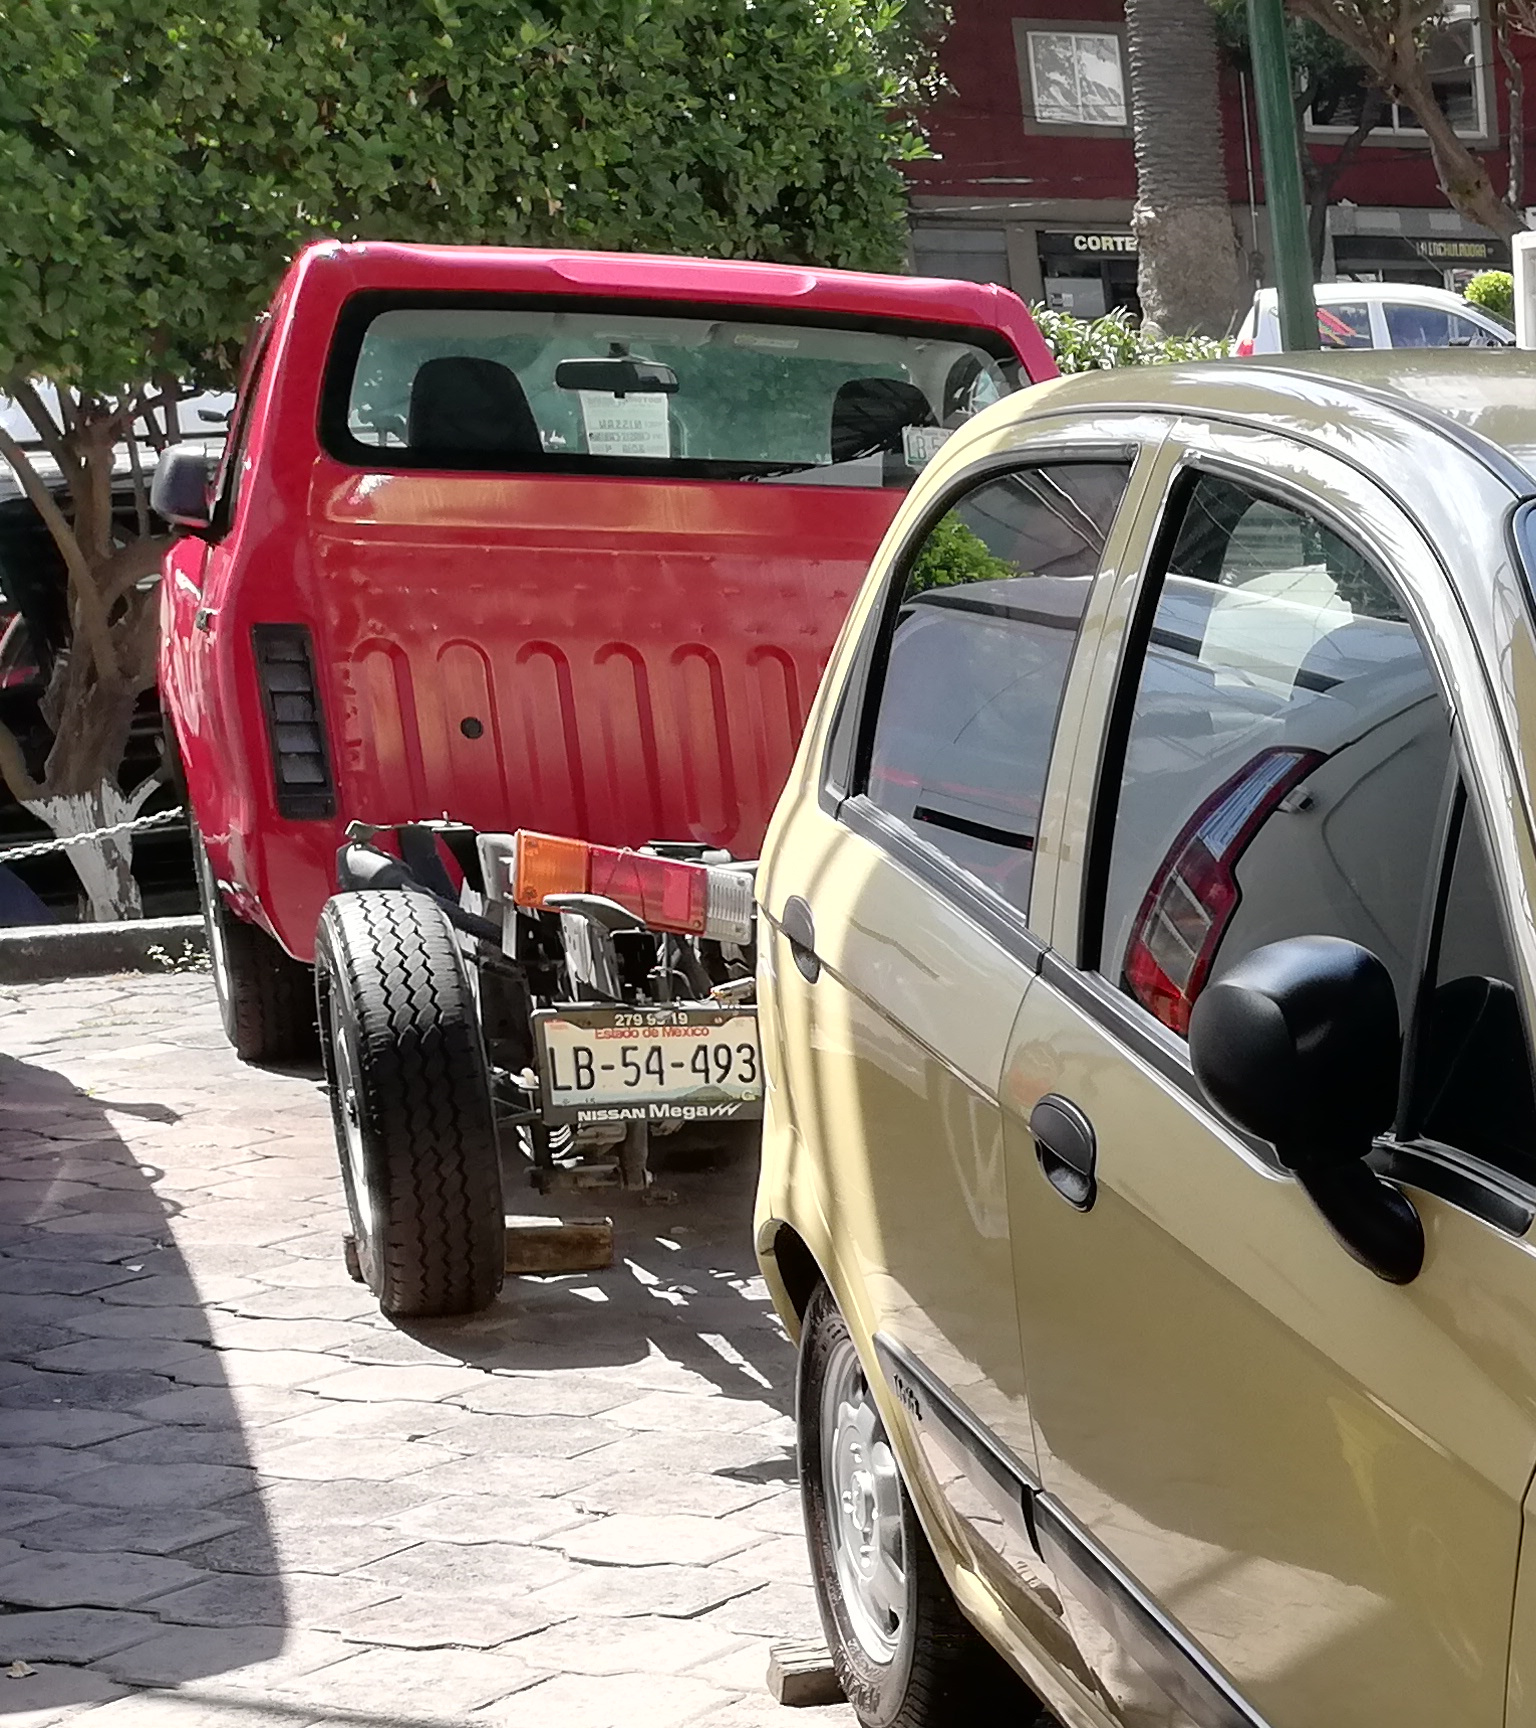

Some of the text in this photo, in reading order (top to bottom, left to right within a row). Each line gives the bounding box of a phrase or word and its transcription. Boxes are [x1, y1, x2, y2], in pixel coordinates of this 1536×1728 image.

[615, 1014, 643, 1027] 279
[671, 1012, 689, 1026] 19
[594, 1027, 640, 1041] Estado
[642, 1026, 660, 1038] de
[548, 1043, 757, 1092] LB-54-493
[578, 1103, 709, 1122] NISSAN Mega
